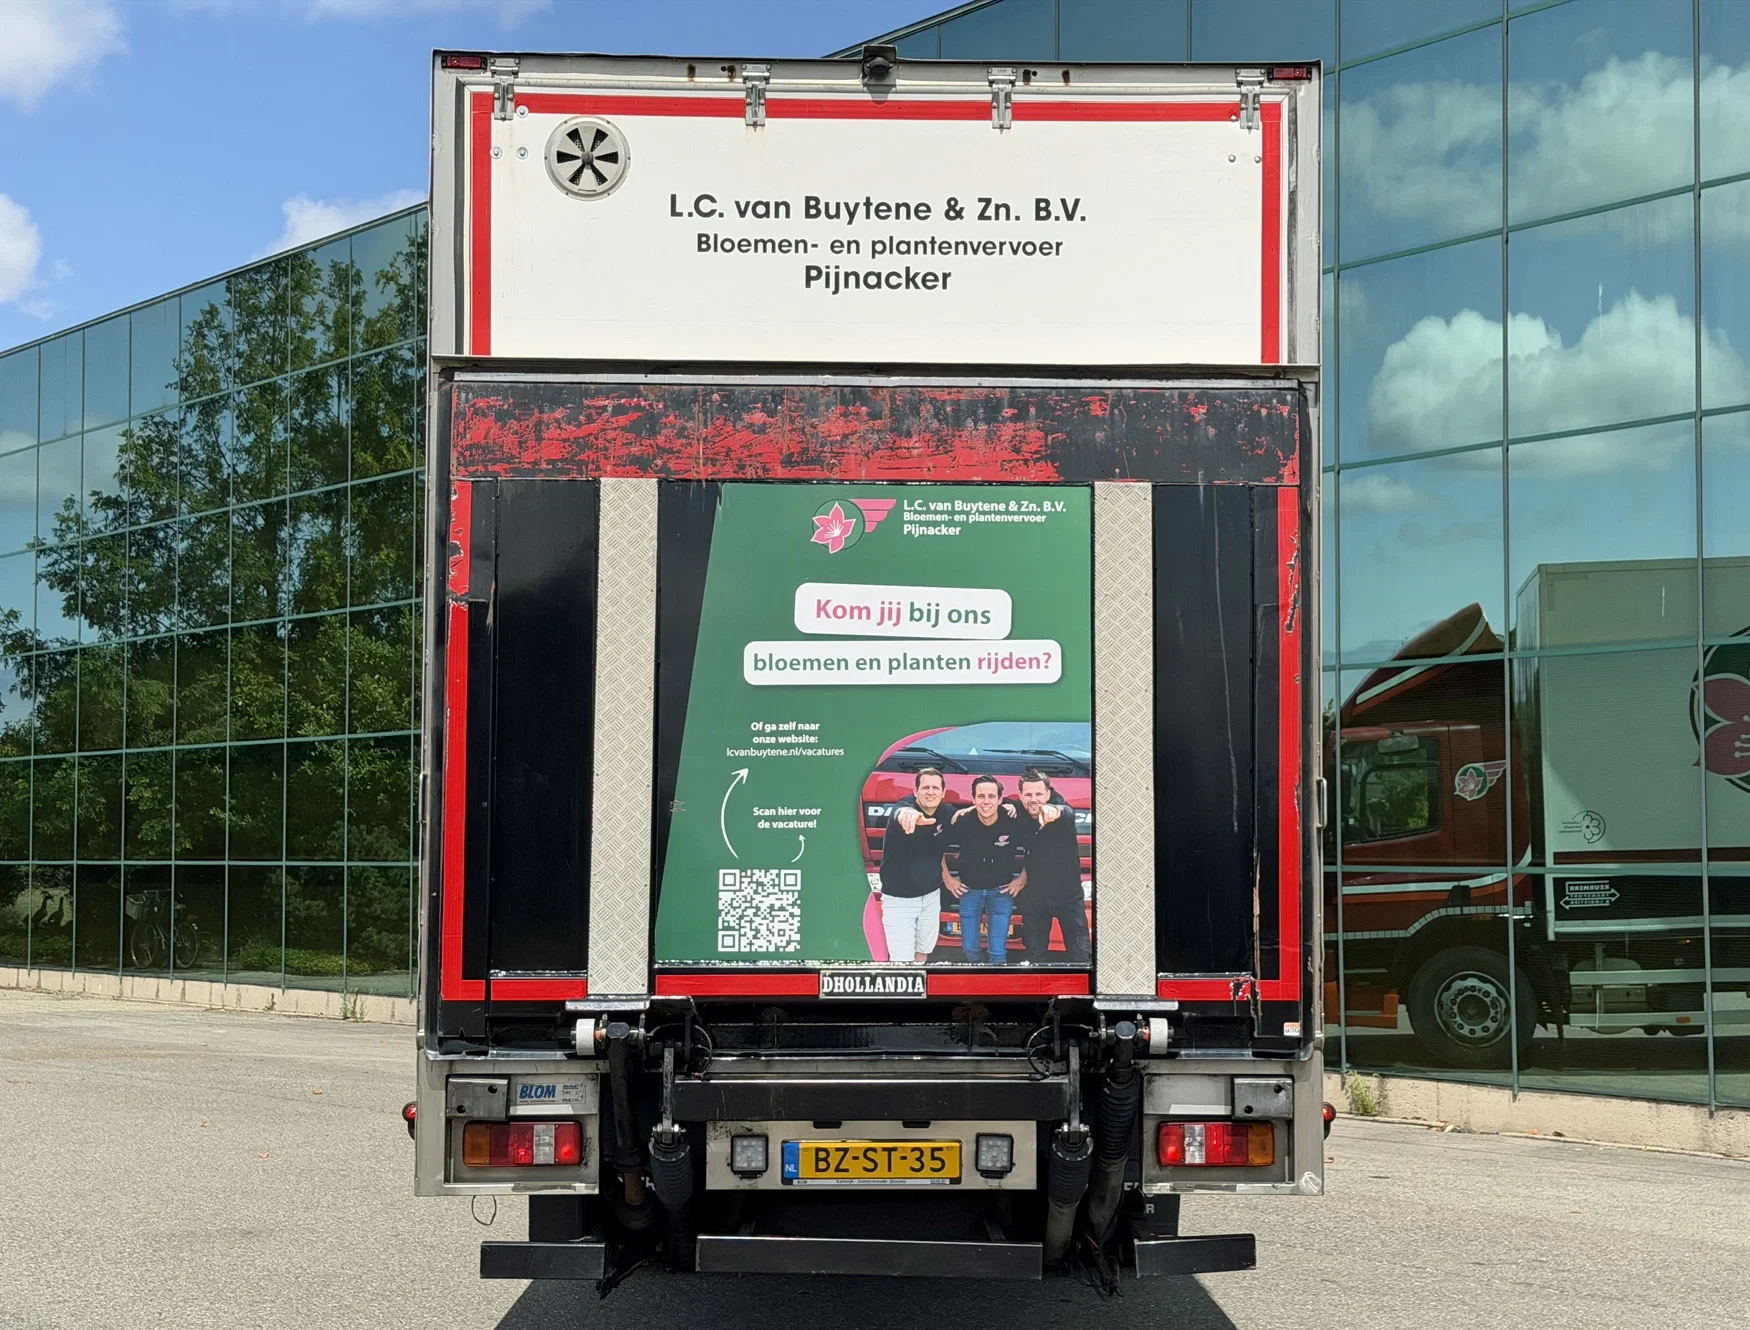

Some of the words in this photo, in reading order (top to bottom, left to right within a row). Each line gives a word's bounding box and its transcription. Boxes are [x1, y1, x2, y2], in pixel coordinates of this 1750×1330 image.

[669, 193, 725, 218] L.C.
[734, 199, 791, 219] van
[804, 195, 932, 225] Buytene
[943, 196, 966, 221] &
[977, 197, 1021, 221] Zn.
[1034, 198, 1087, 222] B.V.
[696, 233, 819, 254] Bloemen-
[829, 239, 861, 254] en
[871, 236, 1063, 259] plantenvervoer
[804, 265, 952, 295] Pijnacker
[903, 499, 926, 511] L.C.
[929, 502, 951, 511] van
[954, 500, 1006, 513] Buytene
[1008, 500, 1018, 512] &
[1020, 500, 1041, 512] Zn.
[1043, 500, 1067, 512] B.V.
[903, 511, 952, 522] Bloemen-
[954, 513, 967, 522] en
[968, 512, 1047, 524] plantenvervoer
[903, 523, 962, 538] Pijnacker
[816, 598, 871, 621] Kom
[876, 600, 902, 627] jij
[909, 601, 940, 629] bij
[947, 608, 992, 625] ons
[753, 652, 849, 672] bloemen
[856, 656, 882, 671] en
[888, 653, 971, 675] planten
[977, 652, 1052, 675] rijden?
[751, 721, 764, 731] Of
[764, 724, 777, 733] ga
[778, 721, 797, 731] zelf
[797, 723, 820, 731] naar
[752, 735, 777, 744] onze
[778, 734, 819, 743] website:
[753, 806, 777, 816] Scan
[777, 806, 798, 816] hier
[799, 808, 822, 816] voor
[757, 819, 771, 829] de
[771, 819, 817, 829] vacature!
[822, 975, 925, 993] DHOLLANDIA
[519, 1084, 557, 1100] BLOM
[813, 1146, 946, 1173] BZ-ST-35
[785, 1163, 798, 1173] NL
